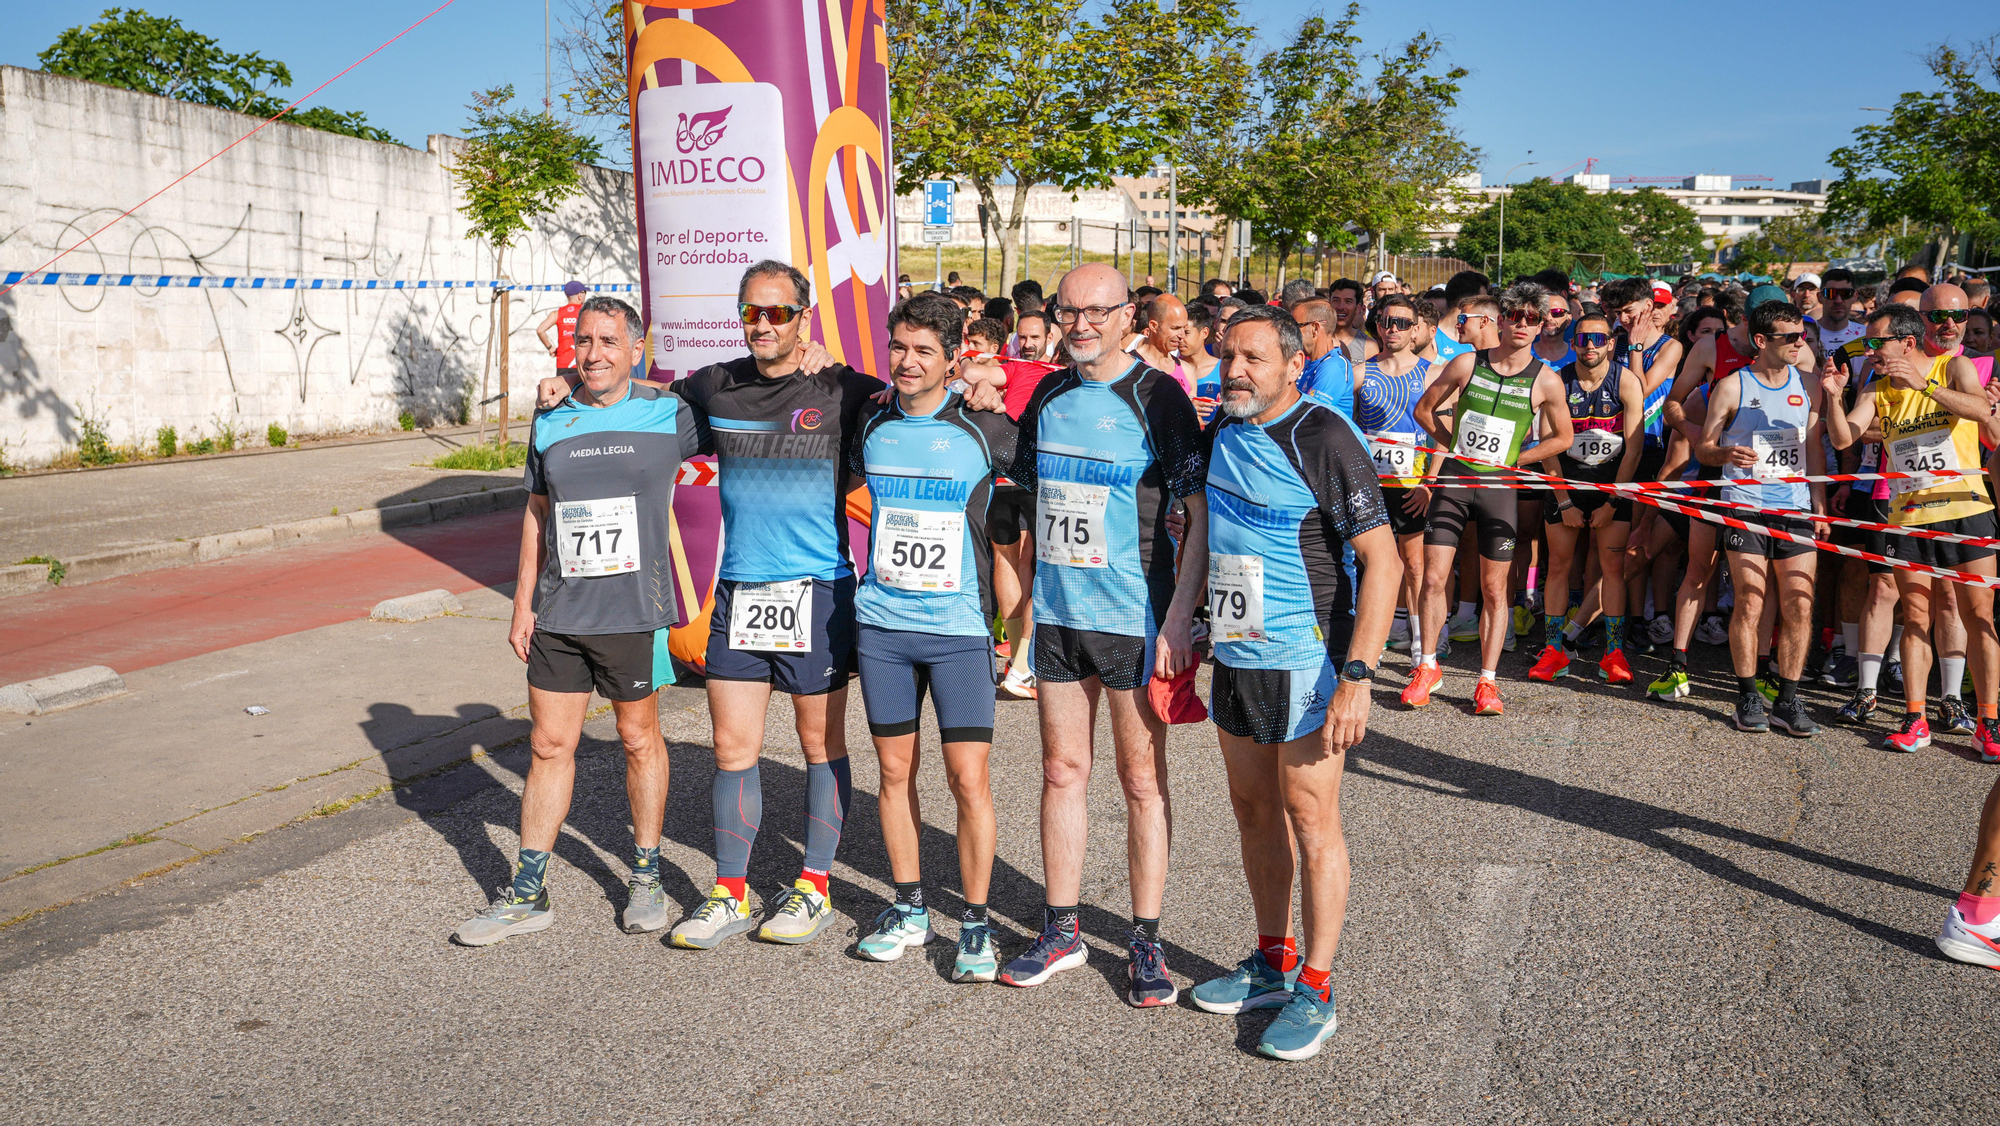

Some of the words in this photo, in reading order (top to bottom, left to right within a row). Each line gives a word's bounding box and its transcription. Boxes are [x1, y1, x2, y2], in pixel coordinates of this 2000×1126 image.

[651, 156, 765, 187] IMDECO
[670, 189, 696, 197] Municipal
[706, 187, 736, 196] Deportes
[656, 232, 675, 245] Por
[678, 229, 690, 244] el
[694, 228, 768, 246] Deporte.
[657, 252, 676, 266] Por
[680, 249, 754, 265] Córdoba.
[1467, 390, 1494, 402] ATLETISMO
[1501, 399, 1528, 410] CORDOBÉS
[1892, 418, 1911, 429] CLUB
[1898, 418, 1950, 435] MONTILLA
[767, 434, 831, 460] LEGUA
[1466, 431, 1500, 453] 928
[1579, 441, 1611, 456] 198
[569, 447, 602, 458] MEDIA
[603, 445, 635, 455] LEGUA
[1090, 448, 1117, 462] BAENA
[1374, 448, 1404, 465] 413
[1766, 448, 1798, 467] 485
[1037, 452, 1071, 481] EDIA
[1074, 460, 1133, 487] LEGUA
[1905, 452, 1946, 472] 345
[928, 467, 955, 478] BAENA
[914, 479, 968, 502] LEGUA
[885, 519, 919, 528] populares
[886, 513, 914, 522] carreras
[1045, 514, 1090, 545] 715
[571, 528, 622, 556] 717
[891, 540, 946, 570] 502
[746, 604, 795, 631] 280
